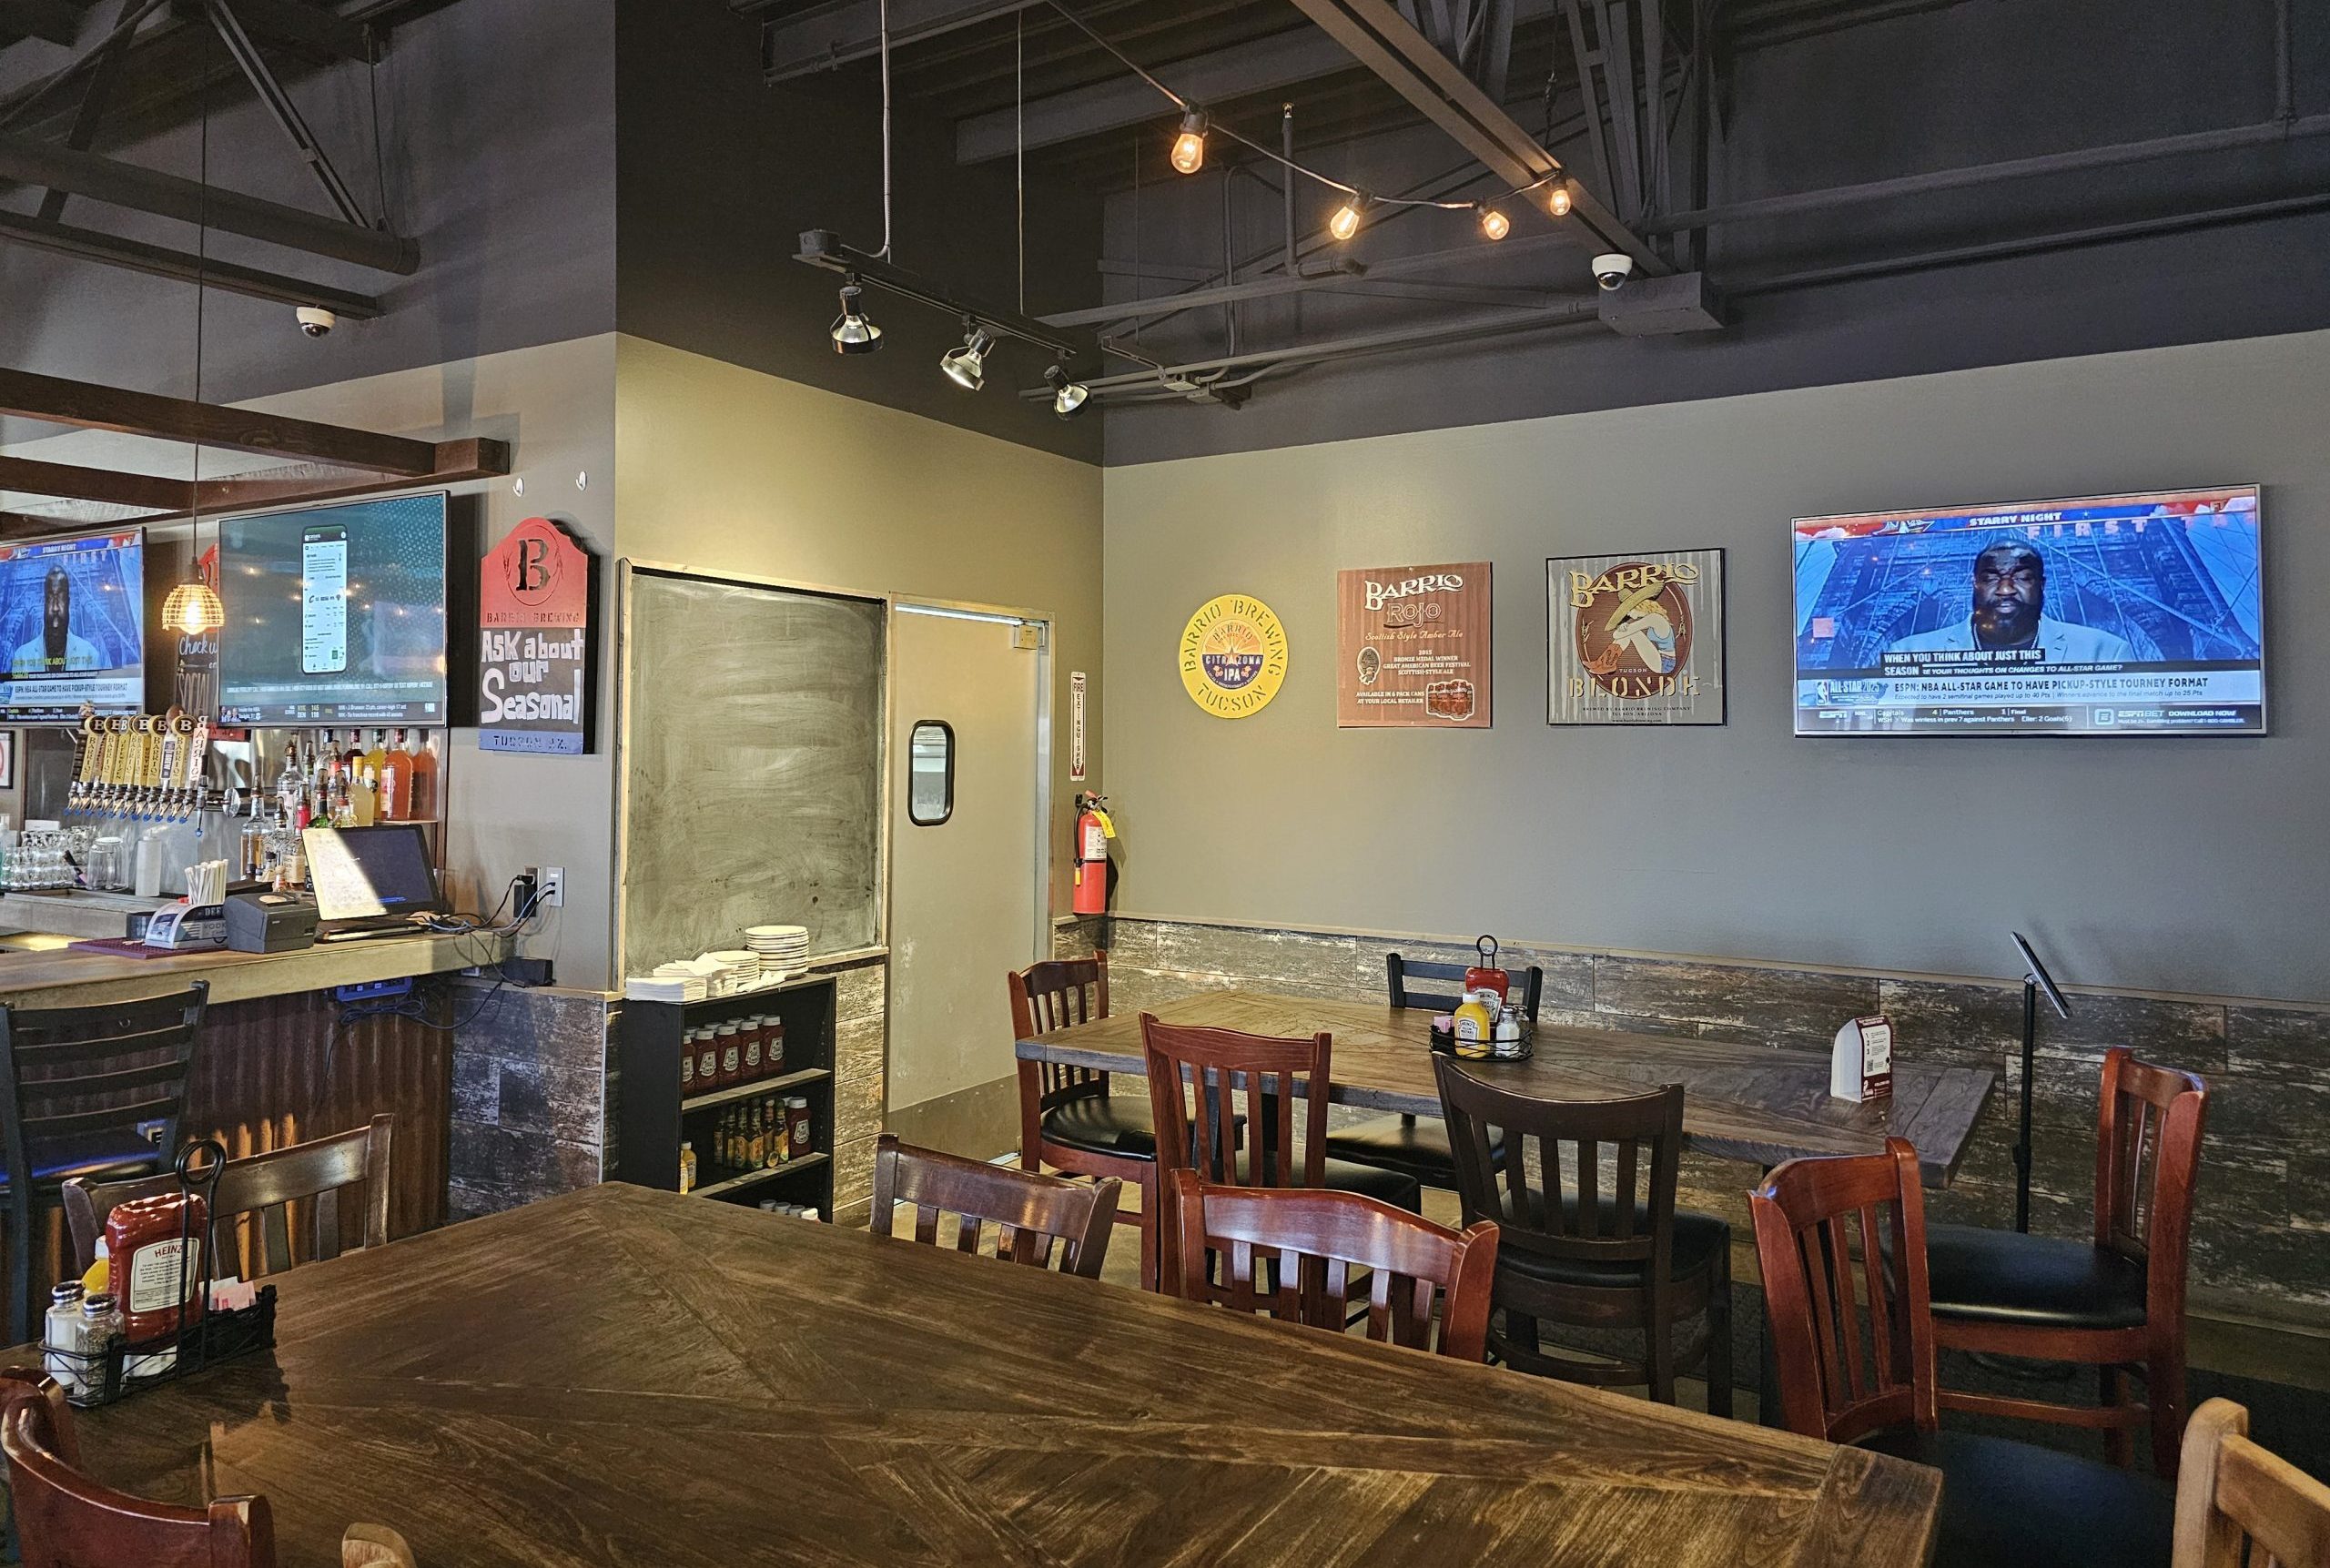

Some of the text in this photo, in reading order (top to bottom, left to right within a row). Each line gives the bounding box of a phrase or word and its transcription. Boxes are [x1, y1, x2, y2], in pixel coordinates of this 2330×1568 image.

[1969, 512, 2062, 527] STARRY NIGHT
[2027, 519, 2148, 540] FIRST
[61, 543, 76, 552] NIGHT
[515, 538, 551, 592] B
[1364, 573, 1464, 612] BARRIO
[1568, 562, 1700, 608] BARRIO
[487, 612, 580, 622] BARRIO BREWING
[179, 632, 208, 655] Check
[524, 628, 585, 660] about
[1184, 600, 1284, 676] BARRIO BREWING
[1364, 629, 1464, 642] Scottish Style Amber Ale
[1884, 649, 2041, 663] WHEN YOU THINK ABOUT JUST THIS
[508, 660, 549, 683] our
[1223, 667, 1241, 682] IPA
[1884, 666, 1920, 676] SEASON
[1568, 674, 1702, 698] BLONDE
[1895, 677, 2208, 692] ESPN: NBA ALL-STAR GAME TO HAVE PICKUP-STYLE TOURNEY FORMAT
[481, 667, 582, 724] Seasonal
[1198, 683, 1266, 711] TUCSON
[180, 719, 192, 731] B
[154, 1244, 183, 1258] HEINZ
